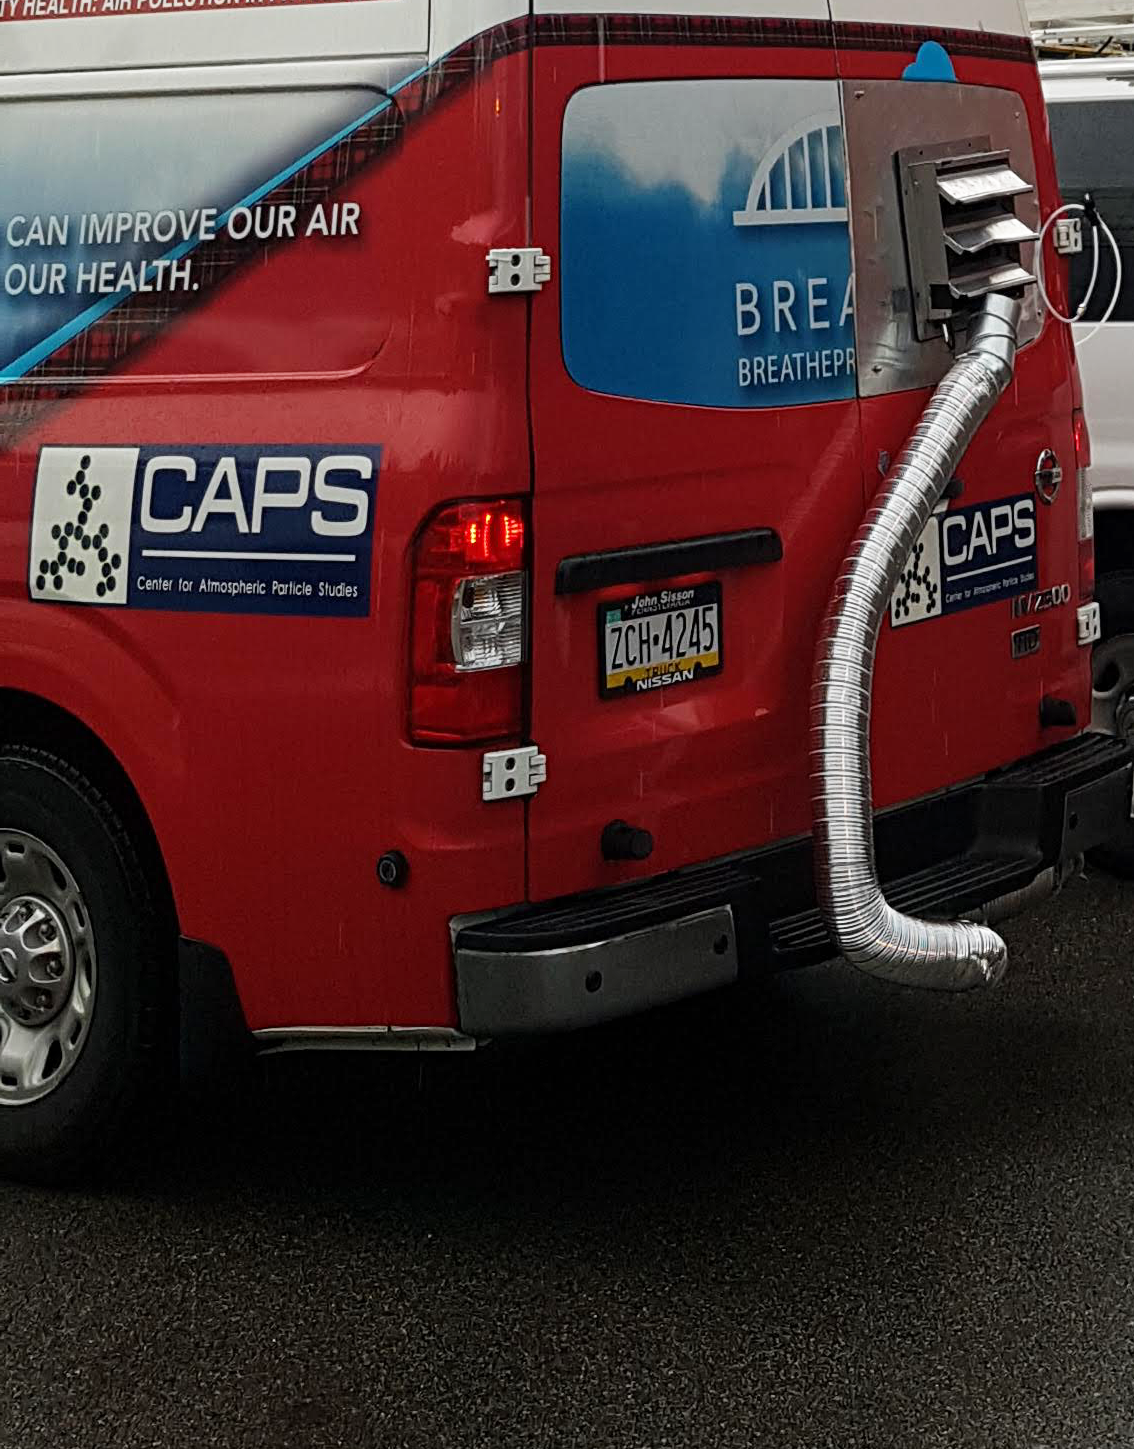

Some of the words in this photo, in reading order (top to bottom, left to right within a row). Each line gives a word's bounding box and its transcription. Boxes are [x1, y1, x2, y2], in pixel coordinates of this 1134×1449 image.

[6, 214, 69, 248] CAN
[79, 208, 217, 245] IMPROVE
[227, 205, 297, 240] OUR
[305, 202, 361, 237] AIR
[4, 261, 67, 296] OUR
[76, 258, 200, 294] HEALTH.
[140, 455, 373, 537] CAPS
[942, 499, 1036, 566] CAPS
[137, 575, 173, 591] Center
[178, 578, 193, 592] for
[198, 578, 266, 597] Atmospheric
[271, 580, 312, 596] Particle
[318, 581, 358, 598] Studies
[631, 595, 658, 610] John
[660, 589, 695, 604] Sisson
[636, 669, 694, 691] NISSAN
